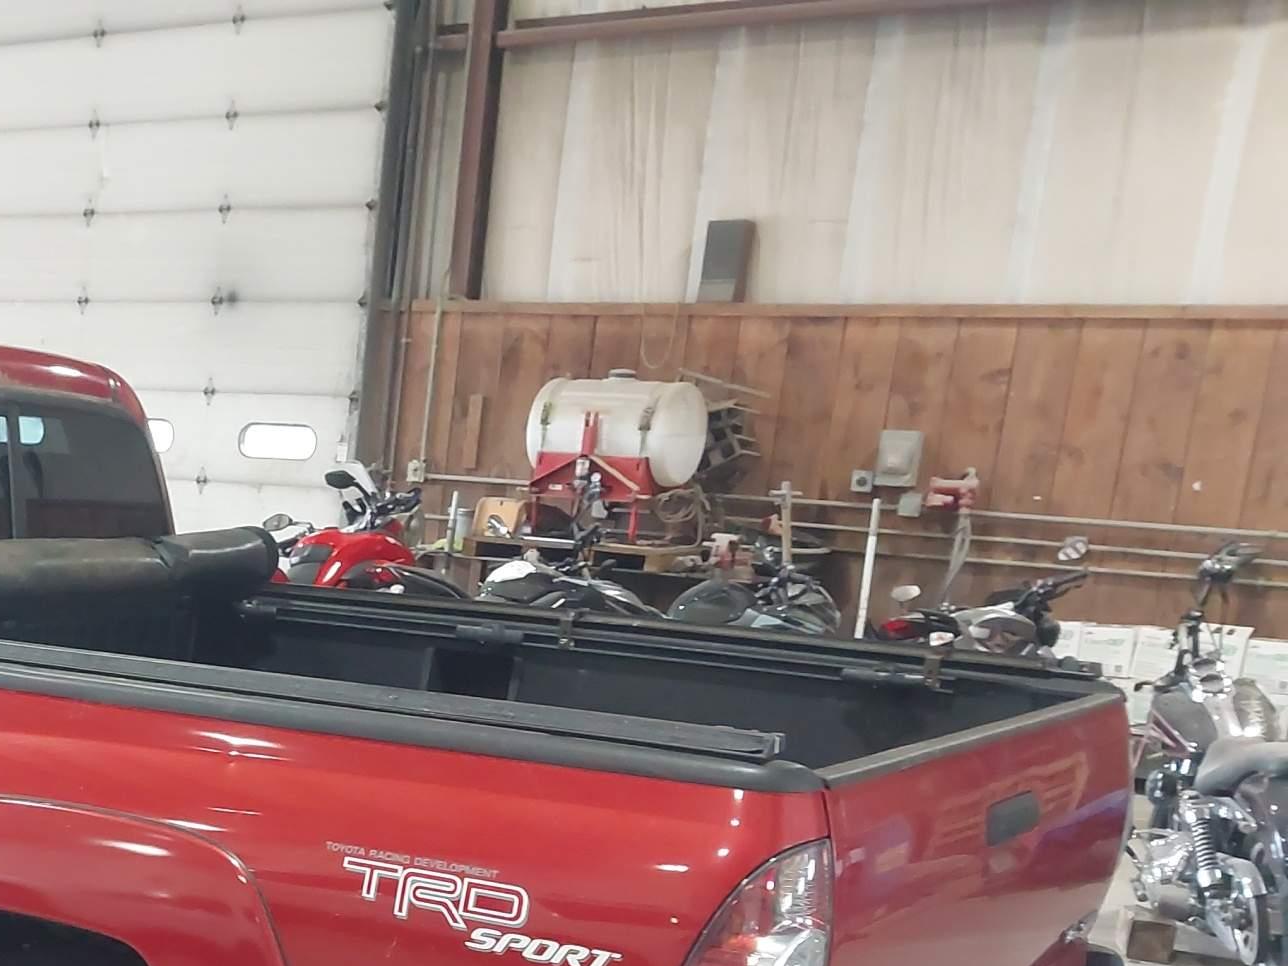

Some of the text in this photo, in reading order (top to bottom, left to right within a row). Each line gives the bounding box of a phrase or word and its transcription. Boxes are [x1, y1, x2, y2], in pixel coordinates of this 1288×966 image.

[324, 841, 500, 879] TOYOTA RACING DEVELOPMENT
[342, 855, 530, 930] TRD
